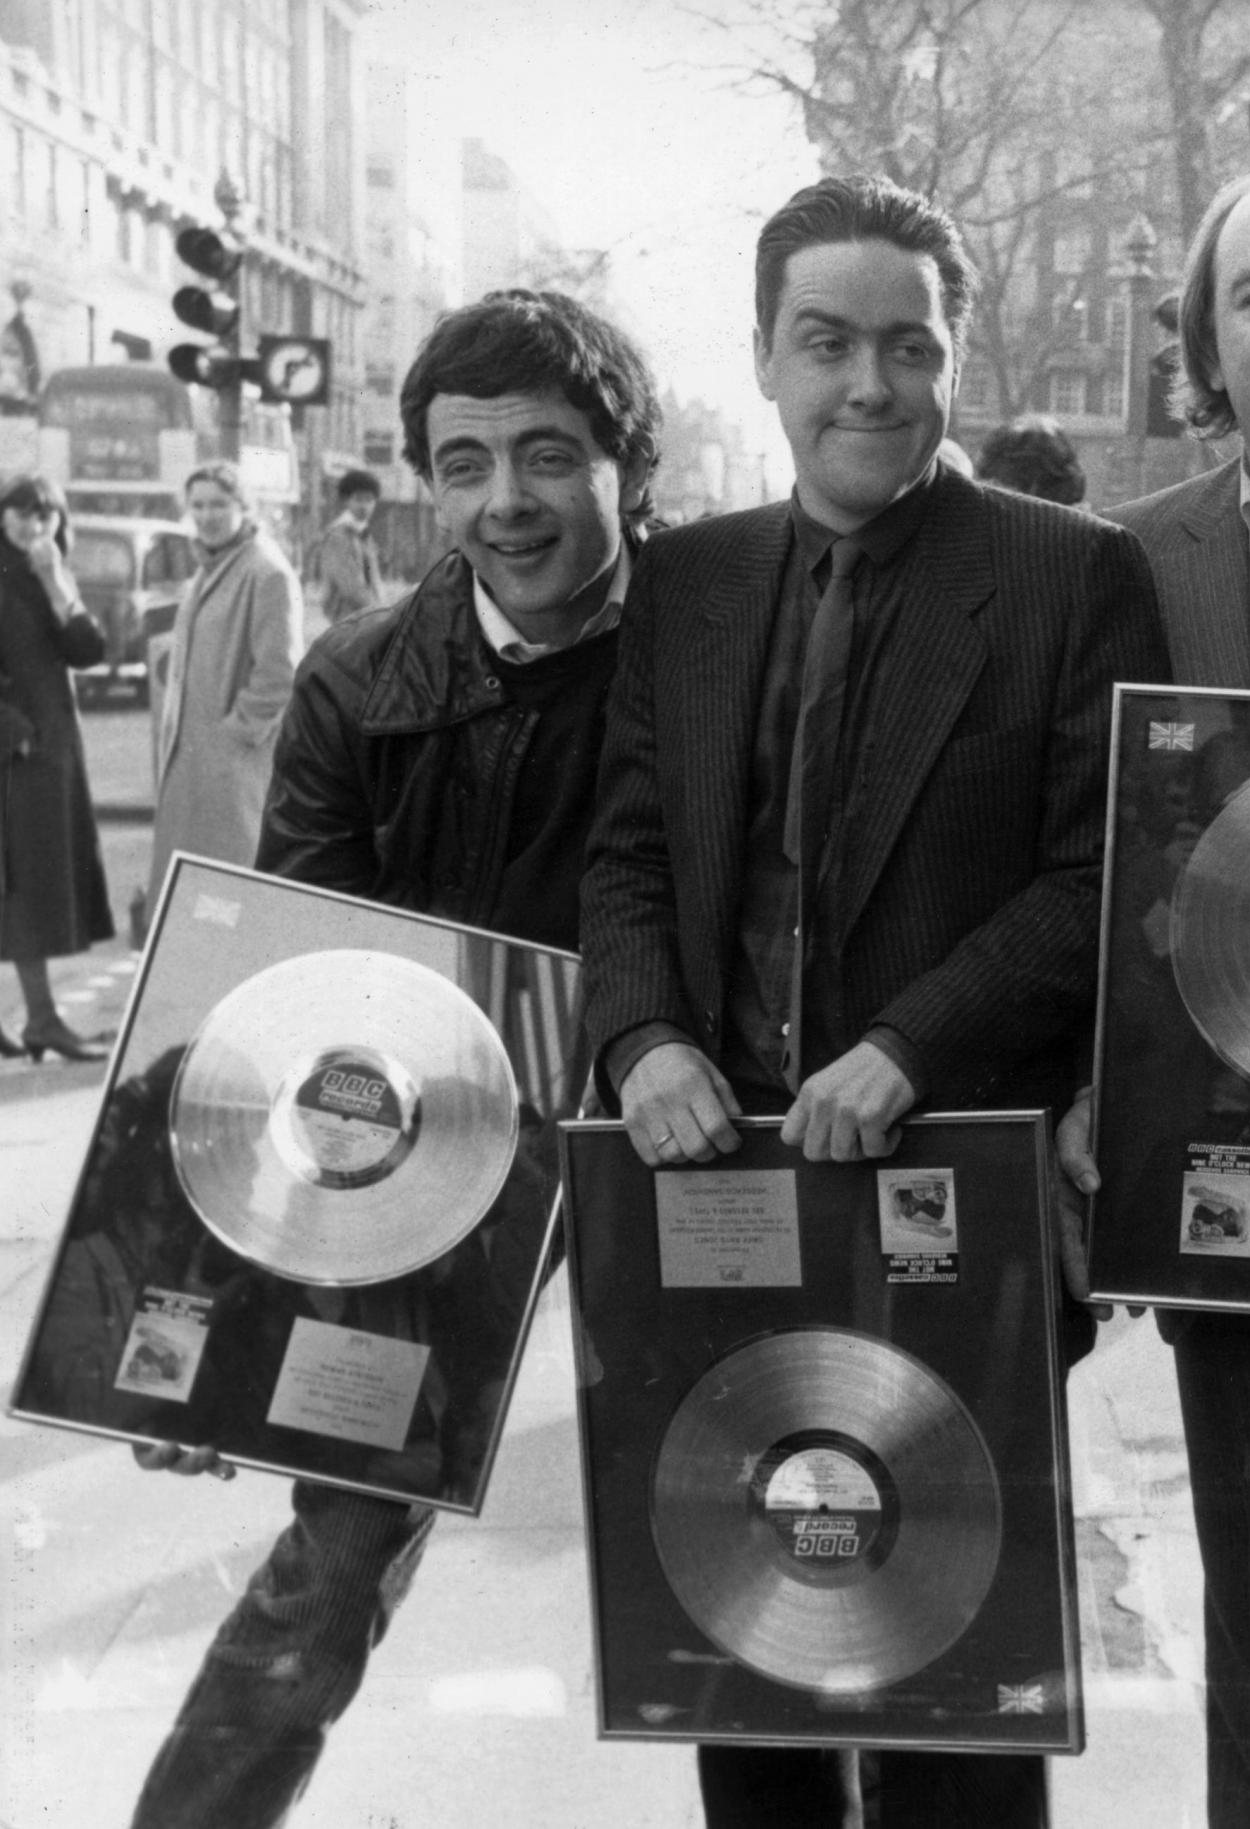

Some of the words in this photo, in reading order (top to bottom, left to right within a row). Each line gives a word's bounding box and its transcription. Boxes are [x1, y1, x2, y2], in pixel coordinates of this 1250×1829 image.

[321, 1071, 386, 1099] BBC
[320, 1090, 381, 1112] records
[795, 1536, 859, 1556] BBC
